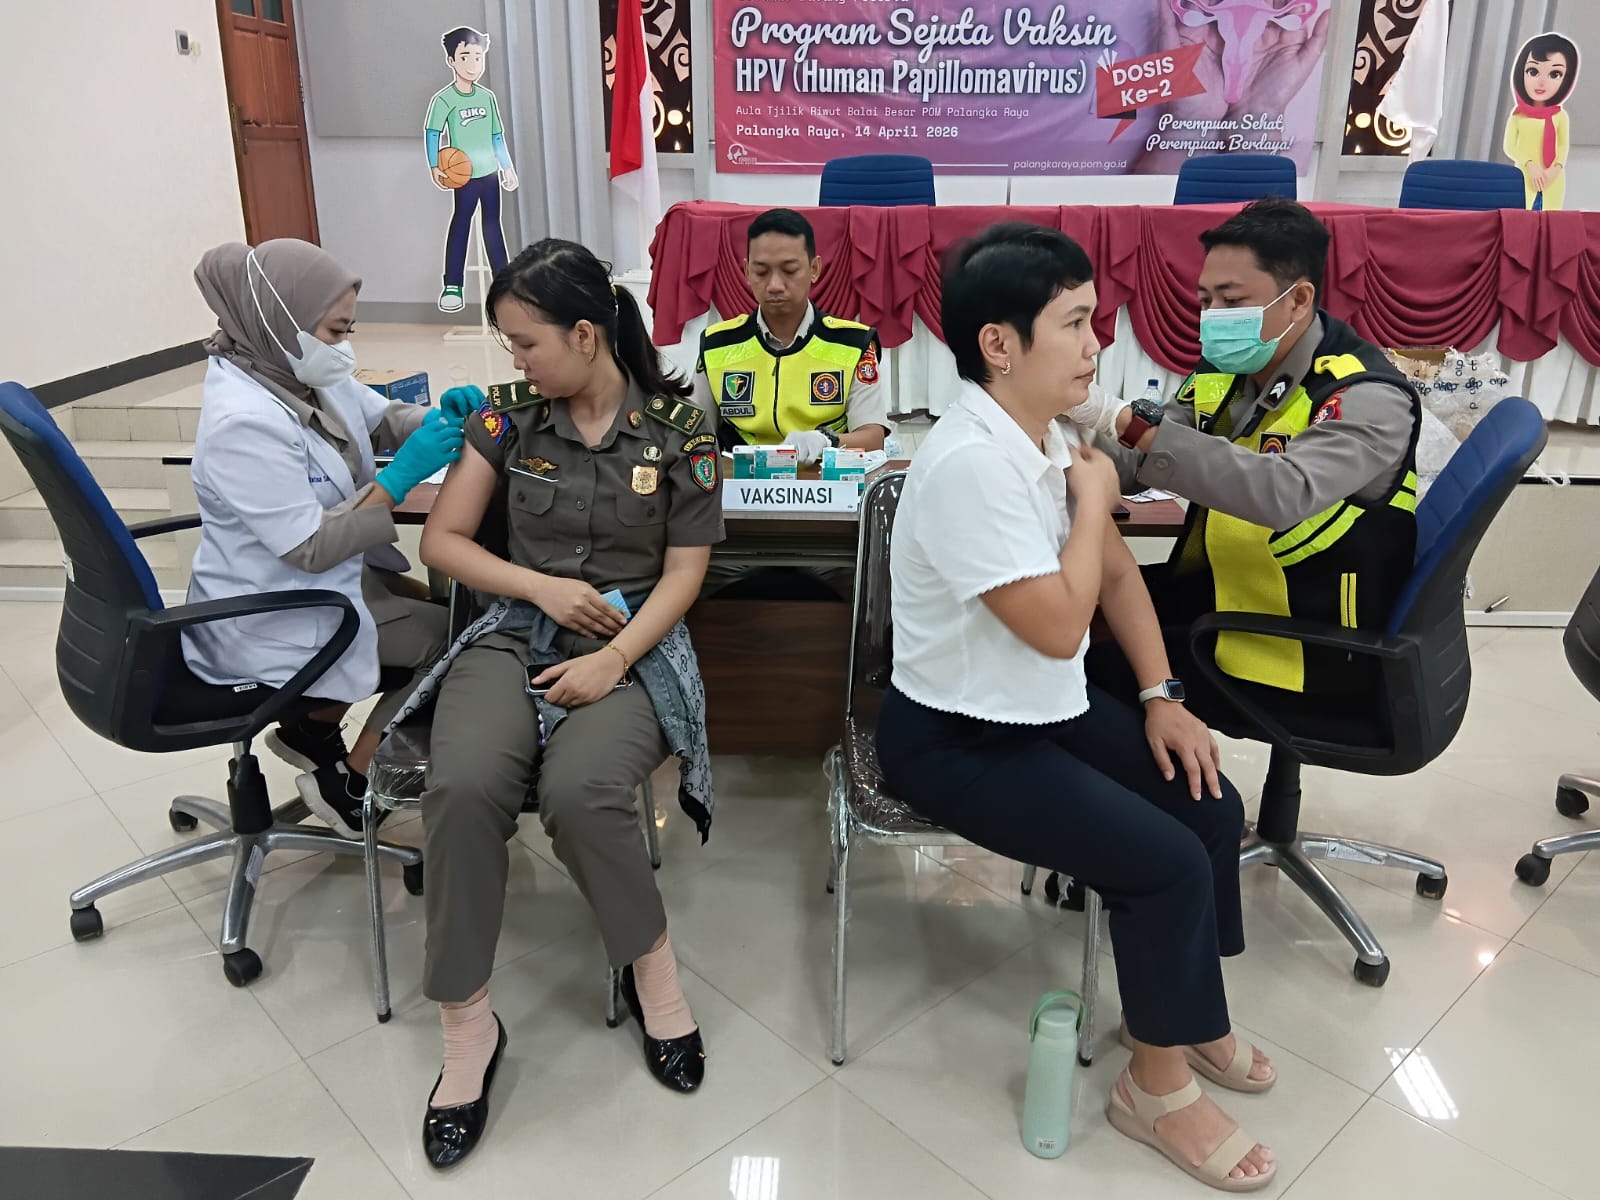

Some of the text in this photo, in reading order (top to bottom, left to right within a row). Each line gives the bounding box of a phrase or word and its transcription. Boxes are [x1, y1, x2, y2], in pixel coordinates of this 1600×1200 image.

[731, 5, 1117, 63] Program Sejuta Vaksin
[736, 58, 1087, 102] HPV (Human Papillomavirus)
[1112, 56, 1174, 86] DOSIS
[1121, 79, 1172, 107] Ke-2
[736, 105, 1029, 119] Aula Tjilik Riwut Balai Besar POM Palangka Raya
[1158, 112, 1285, 137] Perempuan Sehat,
[736, 124, 959, 139] Palangka Raya, 14 April 2026
[1146, 132, 1294, 157] Perempuan Berdaya!
[1013, 160, 1127, 171] palangkaraya.pom.go.id
[722, 407, 752, 415] ABDUL
[740, 487, 832, 504] VAKSINASI
